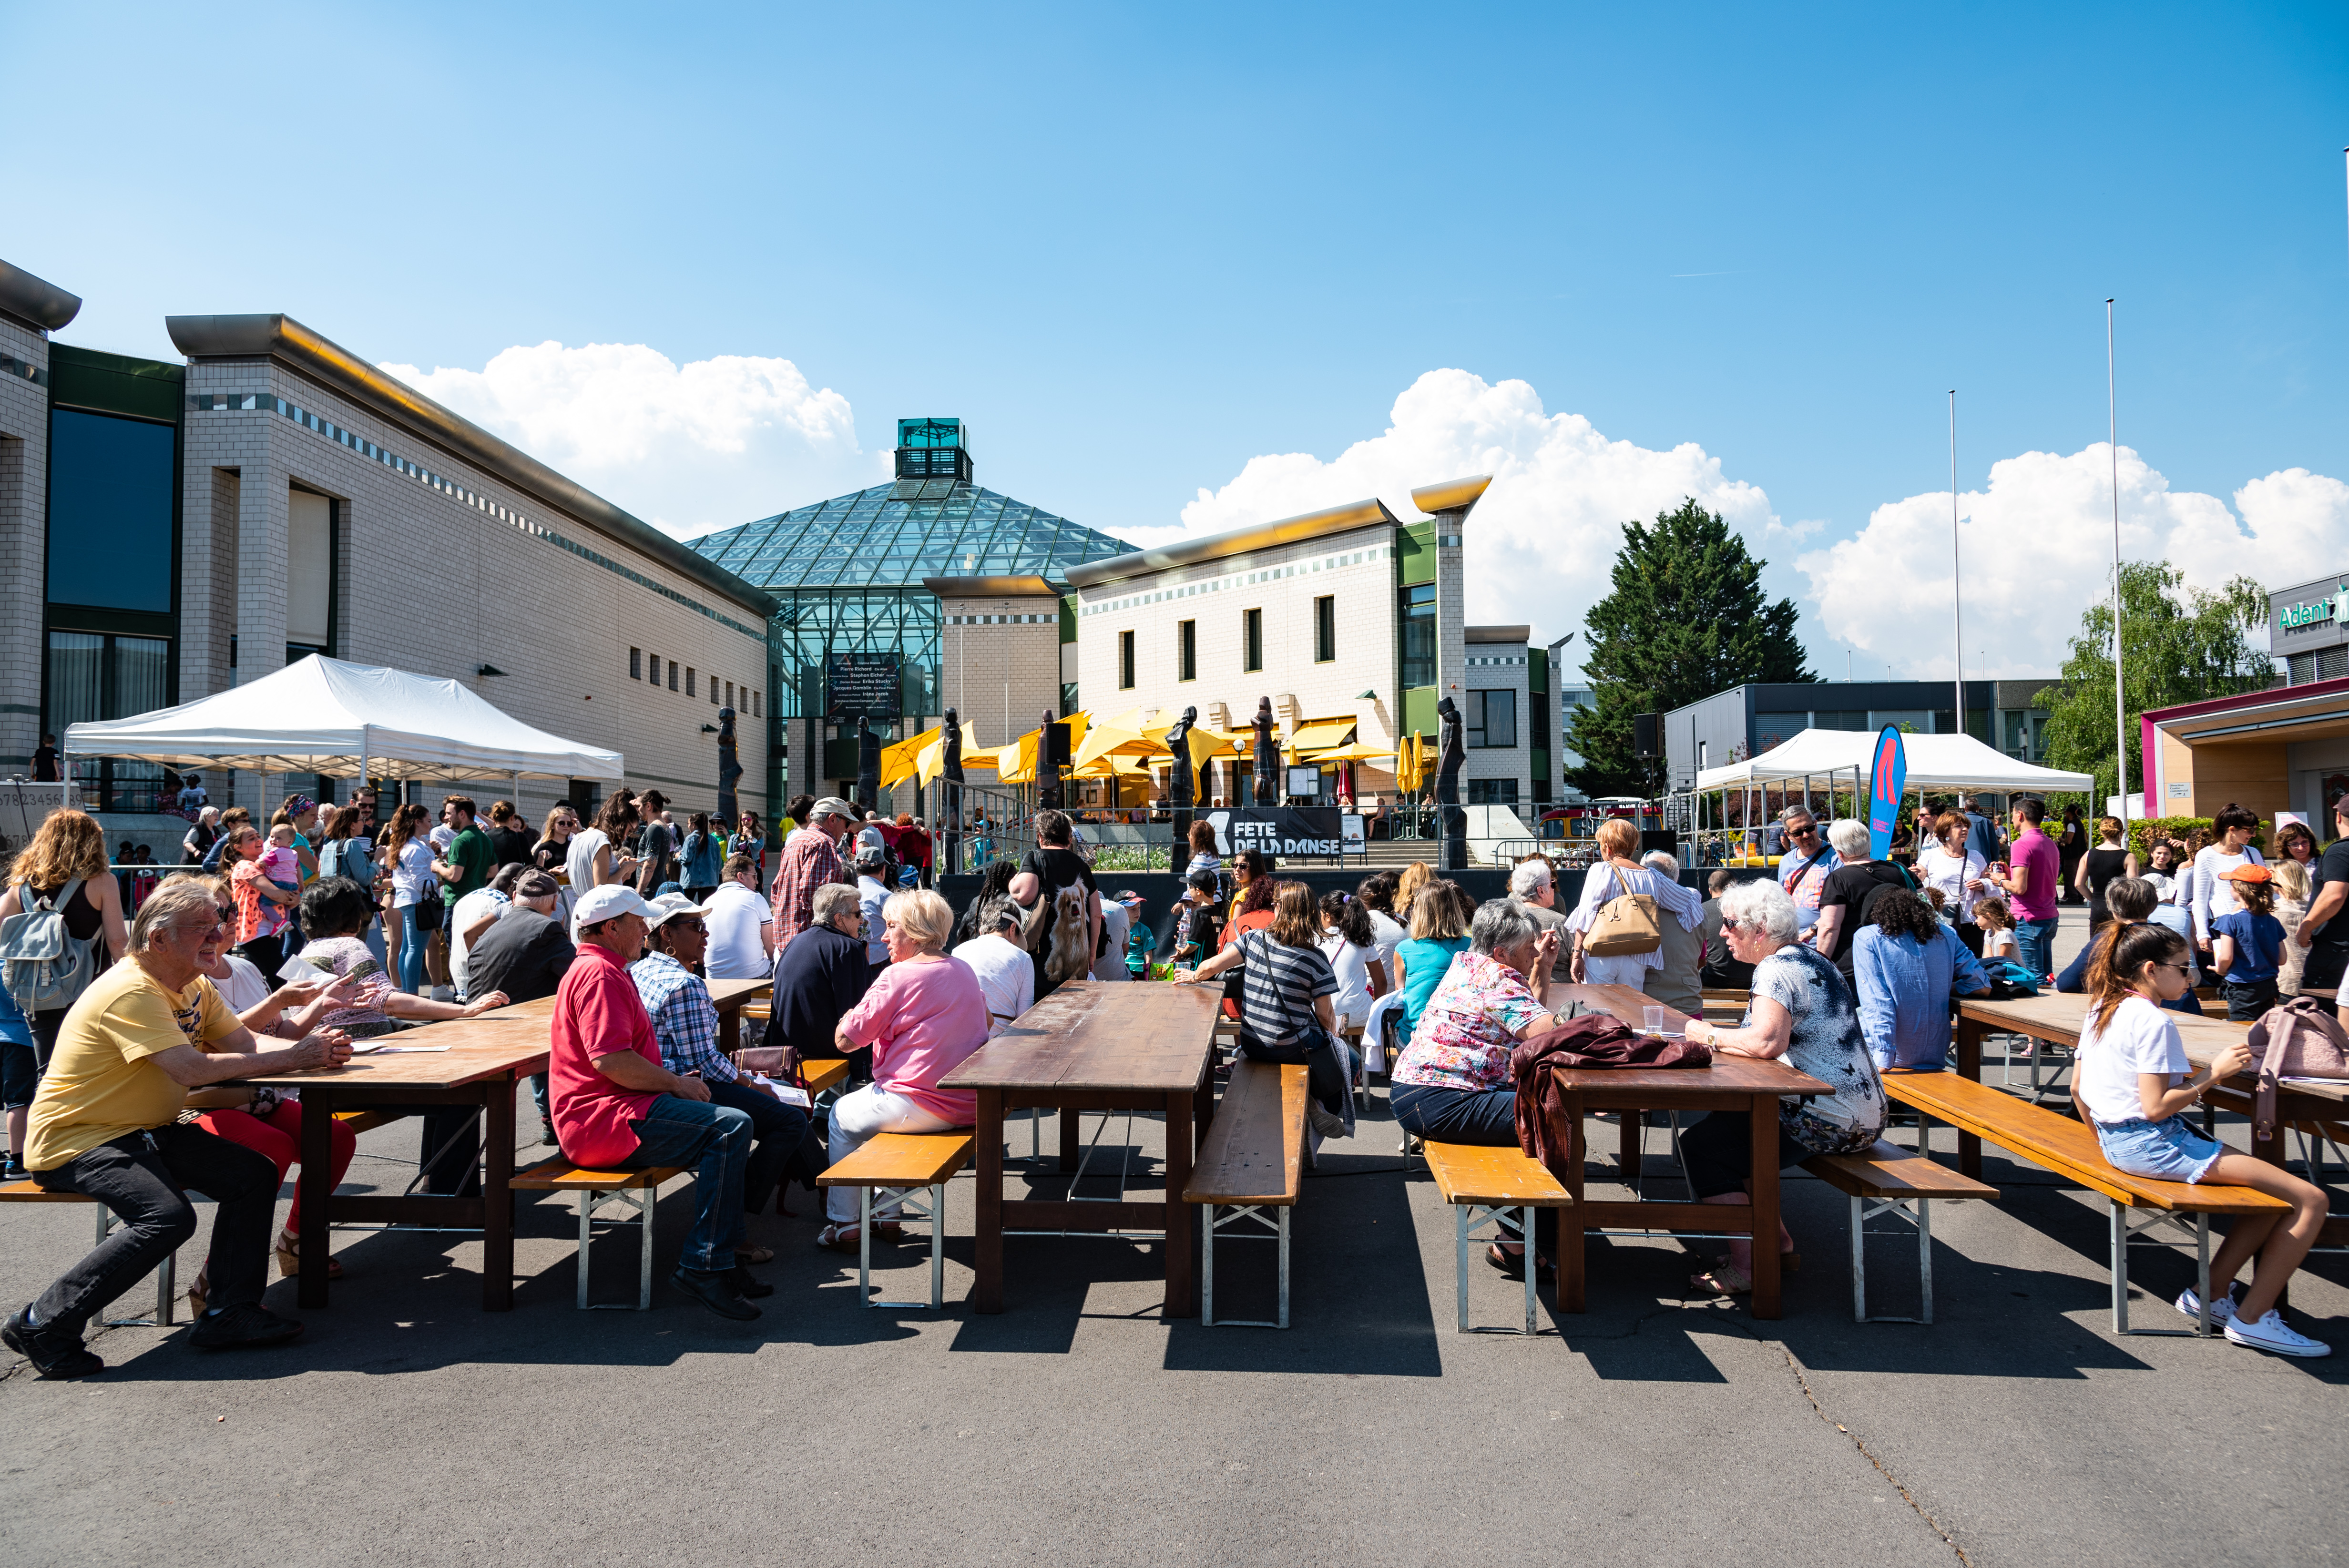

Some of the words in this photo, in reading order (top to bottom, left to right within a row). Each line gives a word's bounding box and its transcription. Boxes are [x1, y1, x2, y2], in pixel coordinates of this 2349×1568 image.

[2279, 598, 2330, 630] Adent
[1234, 822, 1276, 836] FETE
[1235, 839, 1257, 854] DE
[1260, 839, 1281, 854] LA
[1285, 839, 1340, 854] DANSE
